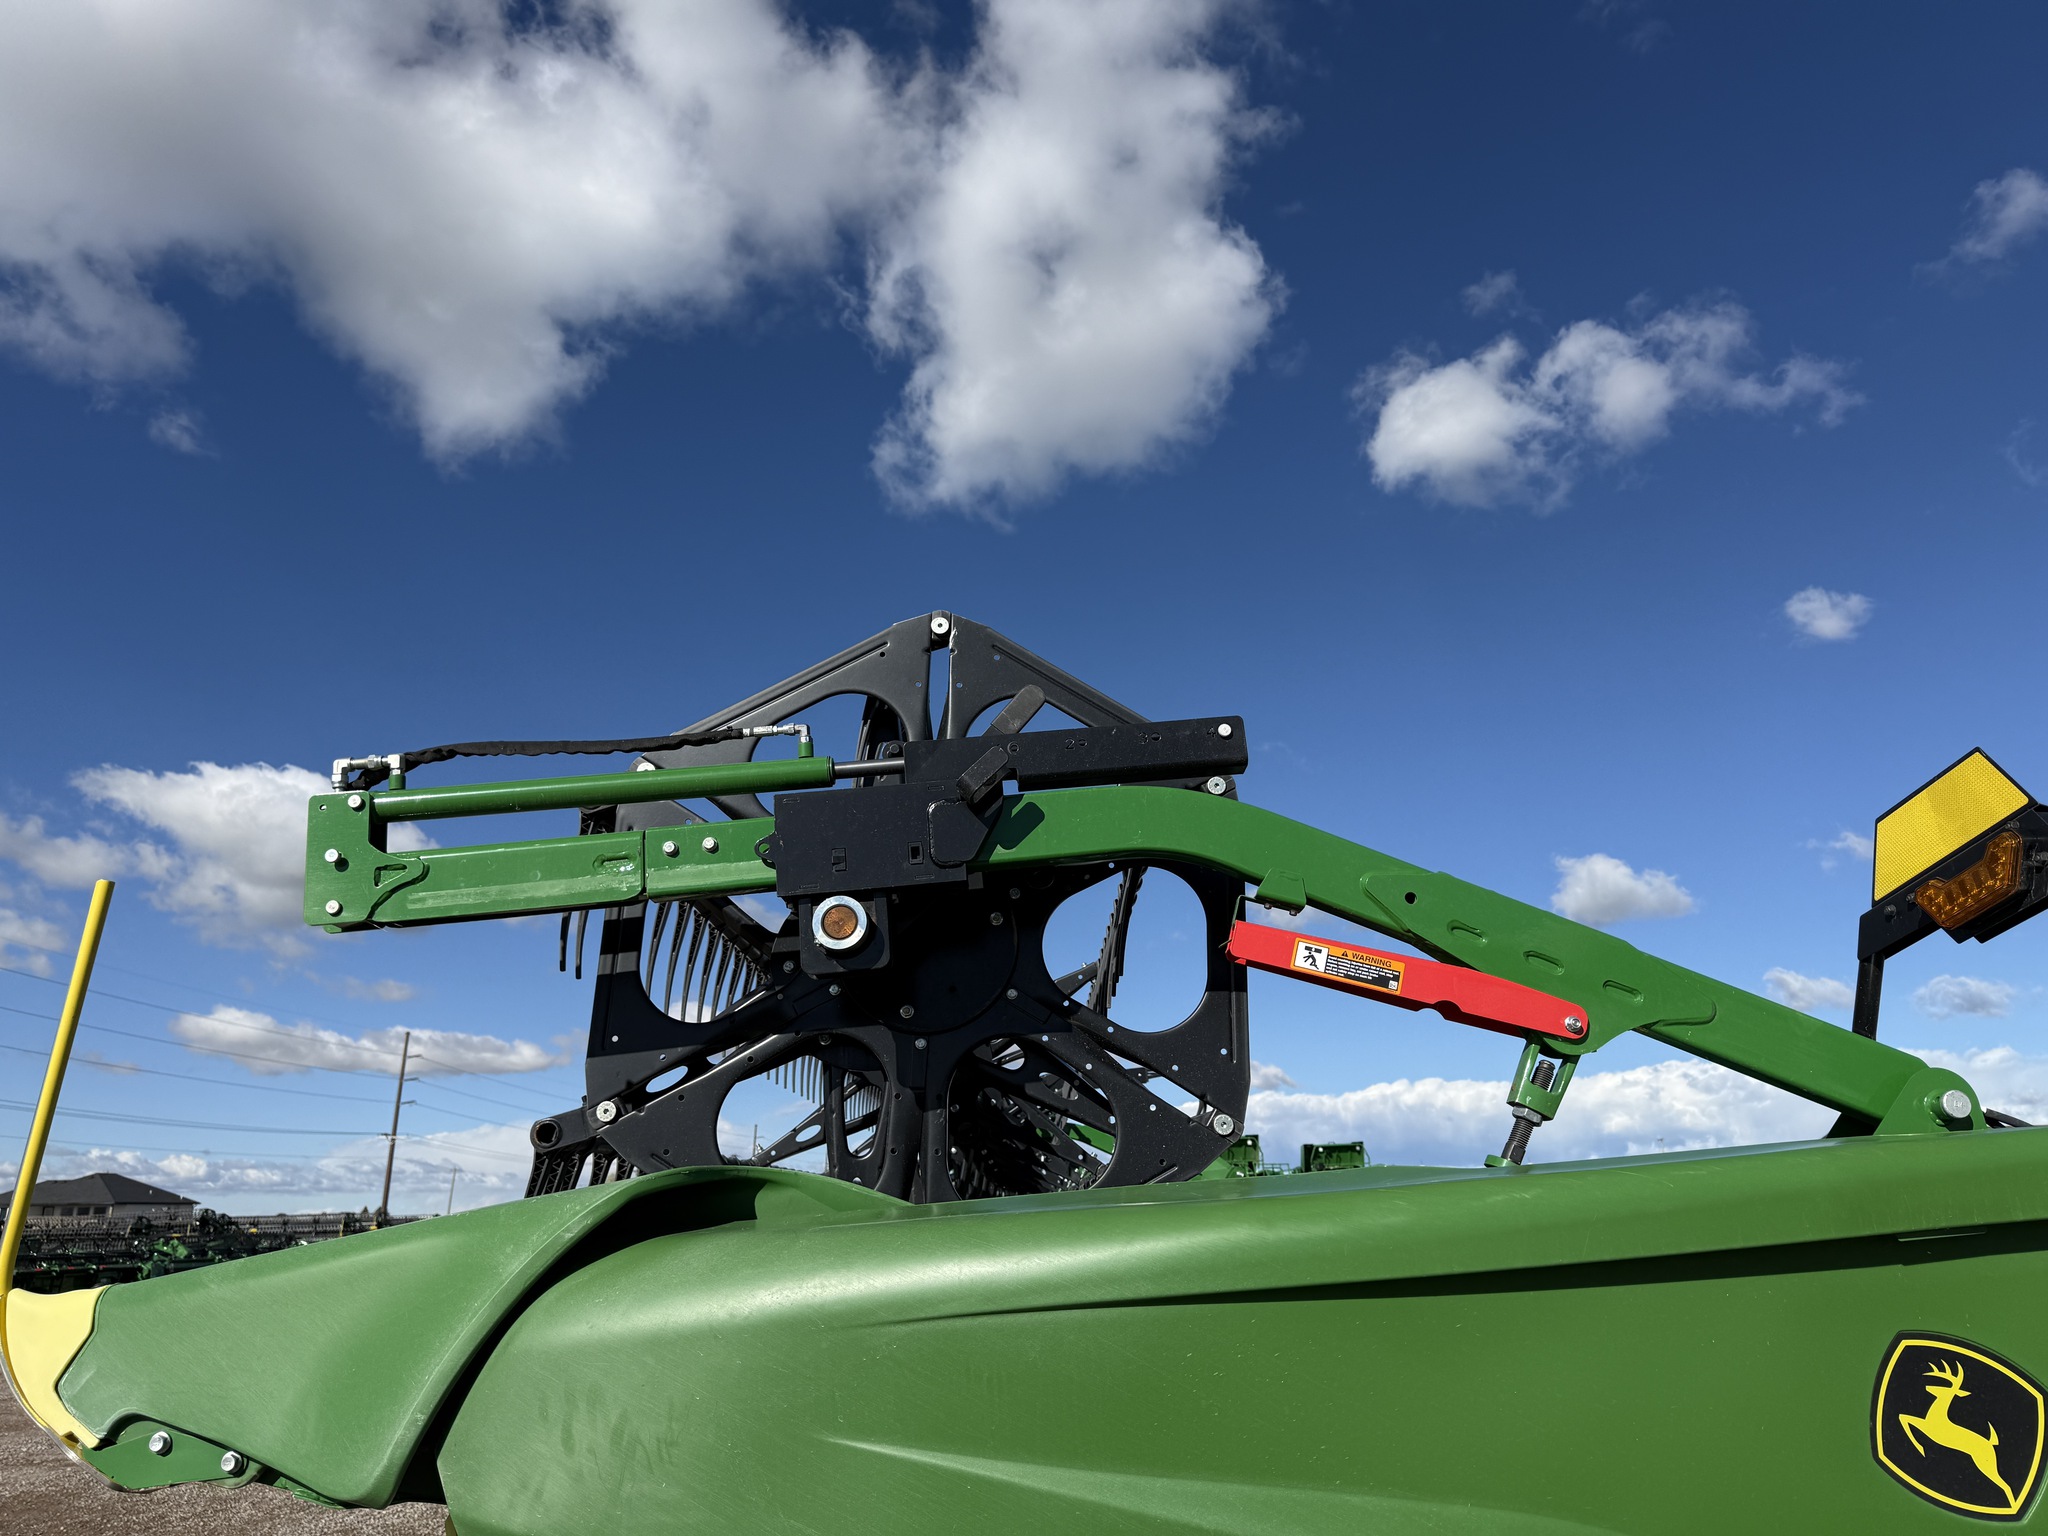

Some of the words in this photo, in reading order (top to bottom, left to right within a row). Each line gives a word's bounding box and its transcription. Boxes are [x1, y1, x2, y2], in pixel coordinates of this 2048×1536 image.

[1064, 737, 1075, 751] 2
[1138, 732, 1149, 745] 3
[1206, 726, 1216, 738] 4
[1351, 952, 1392, 968] WARNING
